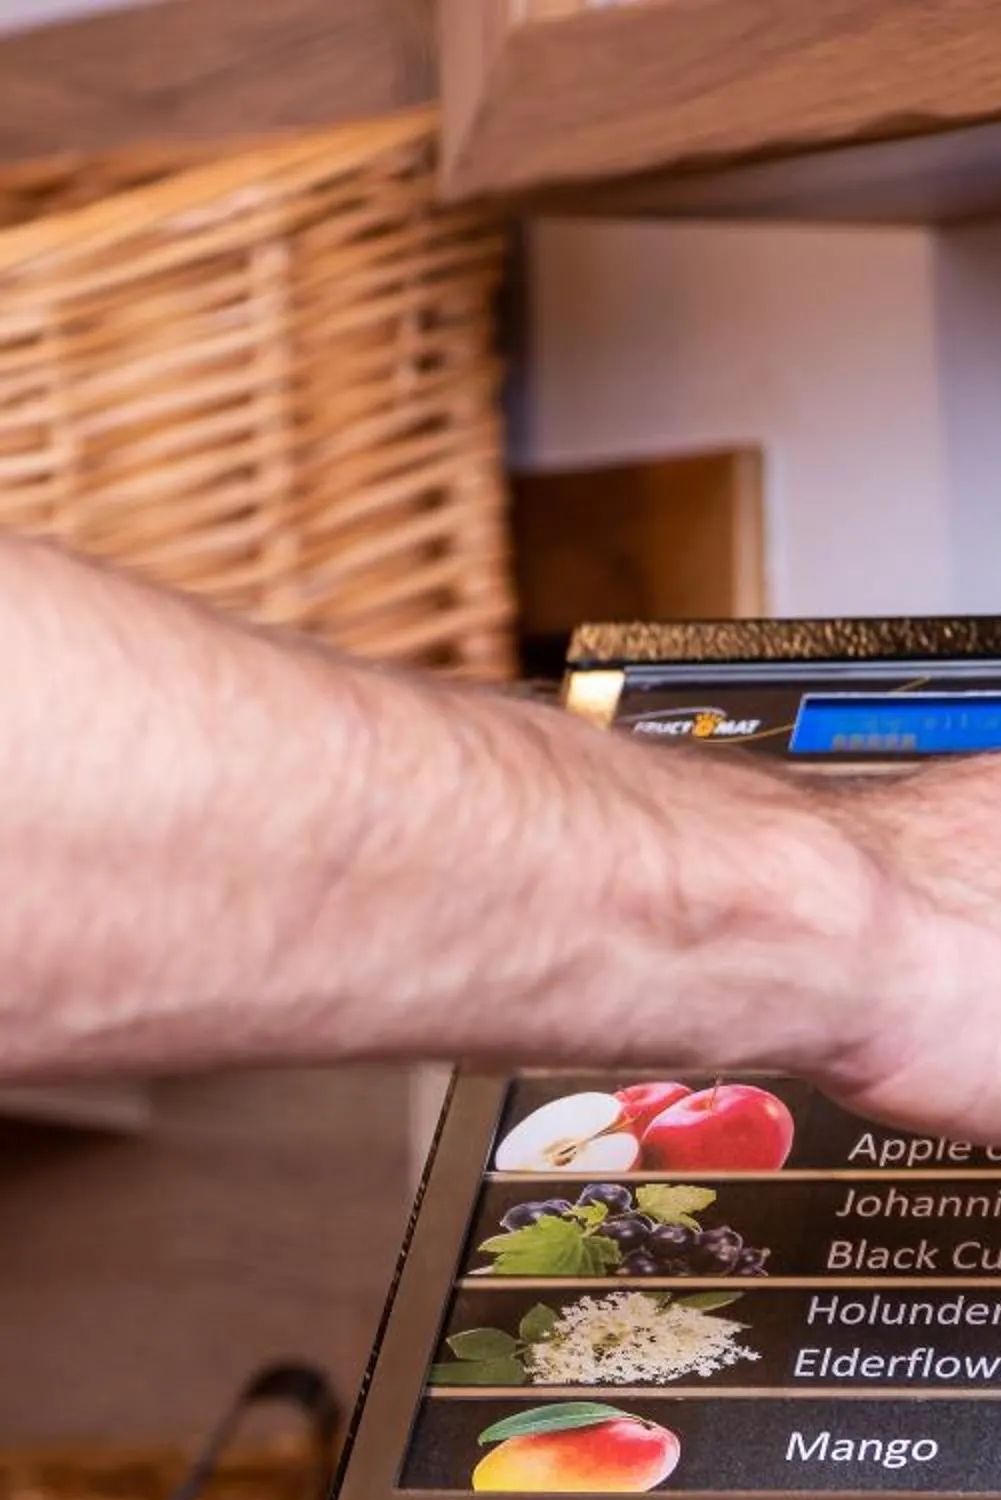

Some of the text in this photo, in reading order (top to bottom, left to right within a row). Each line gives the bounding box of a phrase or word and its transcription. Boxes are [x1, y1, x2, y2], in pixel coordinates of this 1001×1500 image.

[847, 1132, 972, 1167] Apple
[826, 1241, 938, 1270] Black
[785, 1431, 939, 1469] Mango
